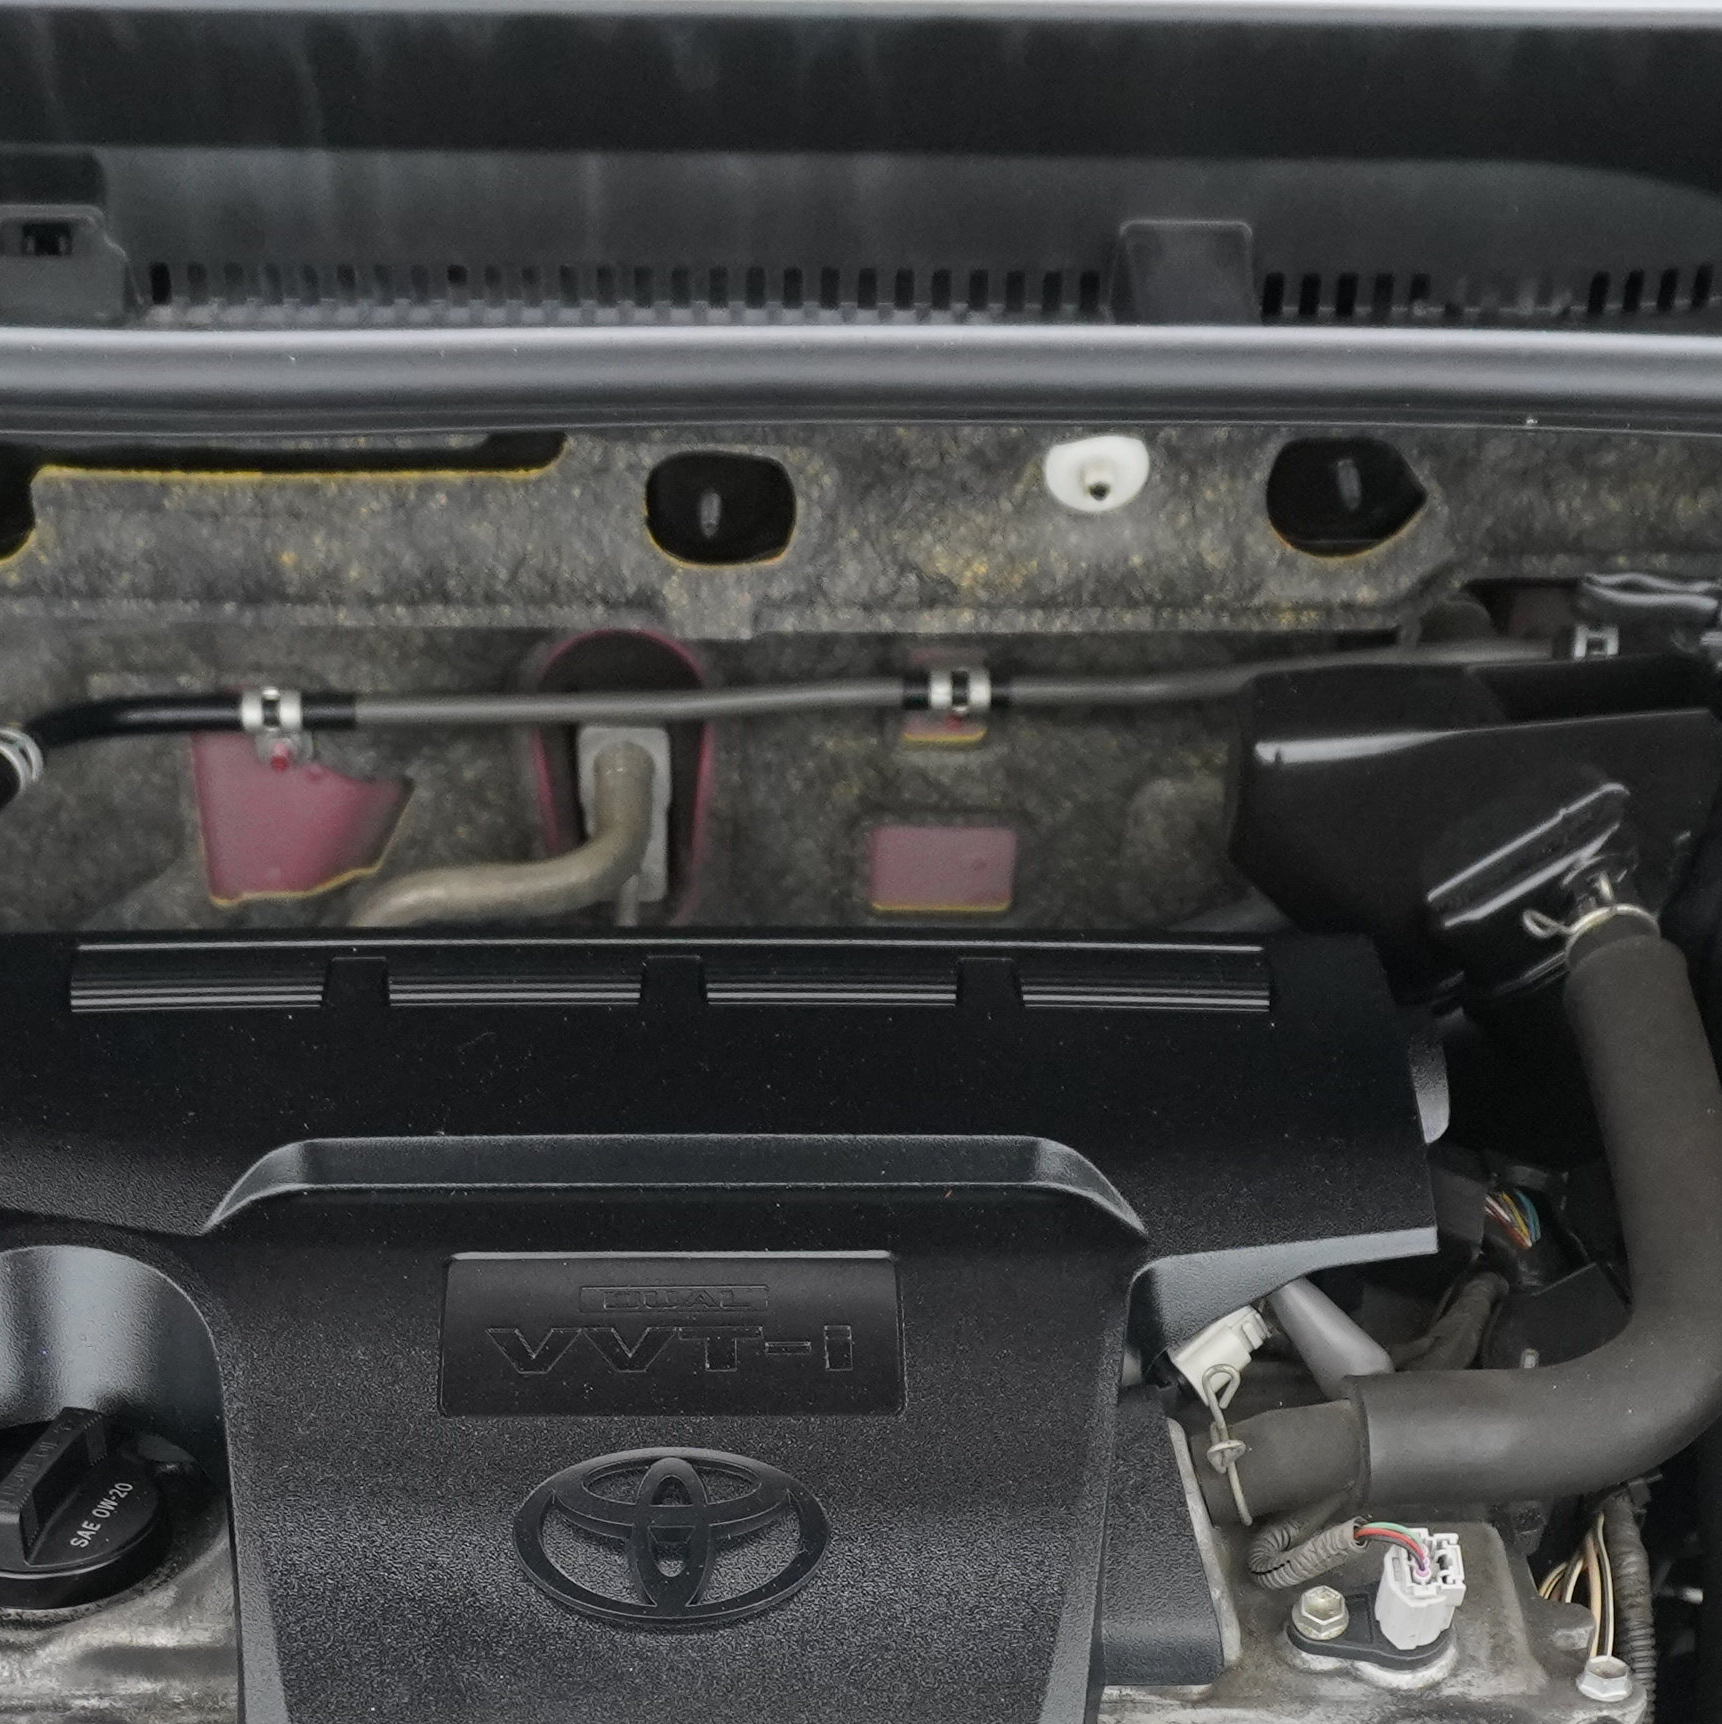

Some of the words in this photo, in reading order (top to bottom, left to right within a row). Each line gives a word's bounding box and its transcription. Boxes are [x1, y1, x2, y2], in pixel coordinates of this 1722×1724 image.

[485, 1325, 855, 1374] VVT-i
[69, 1519, 102, 1549] SAE
[91, 1481, 134, 1519] 0W-20
